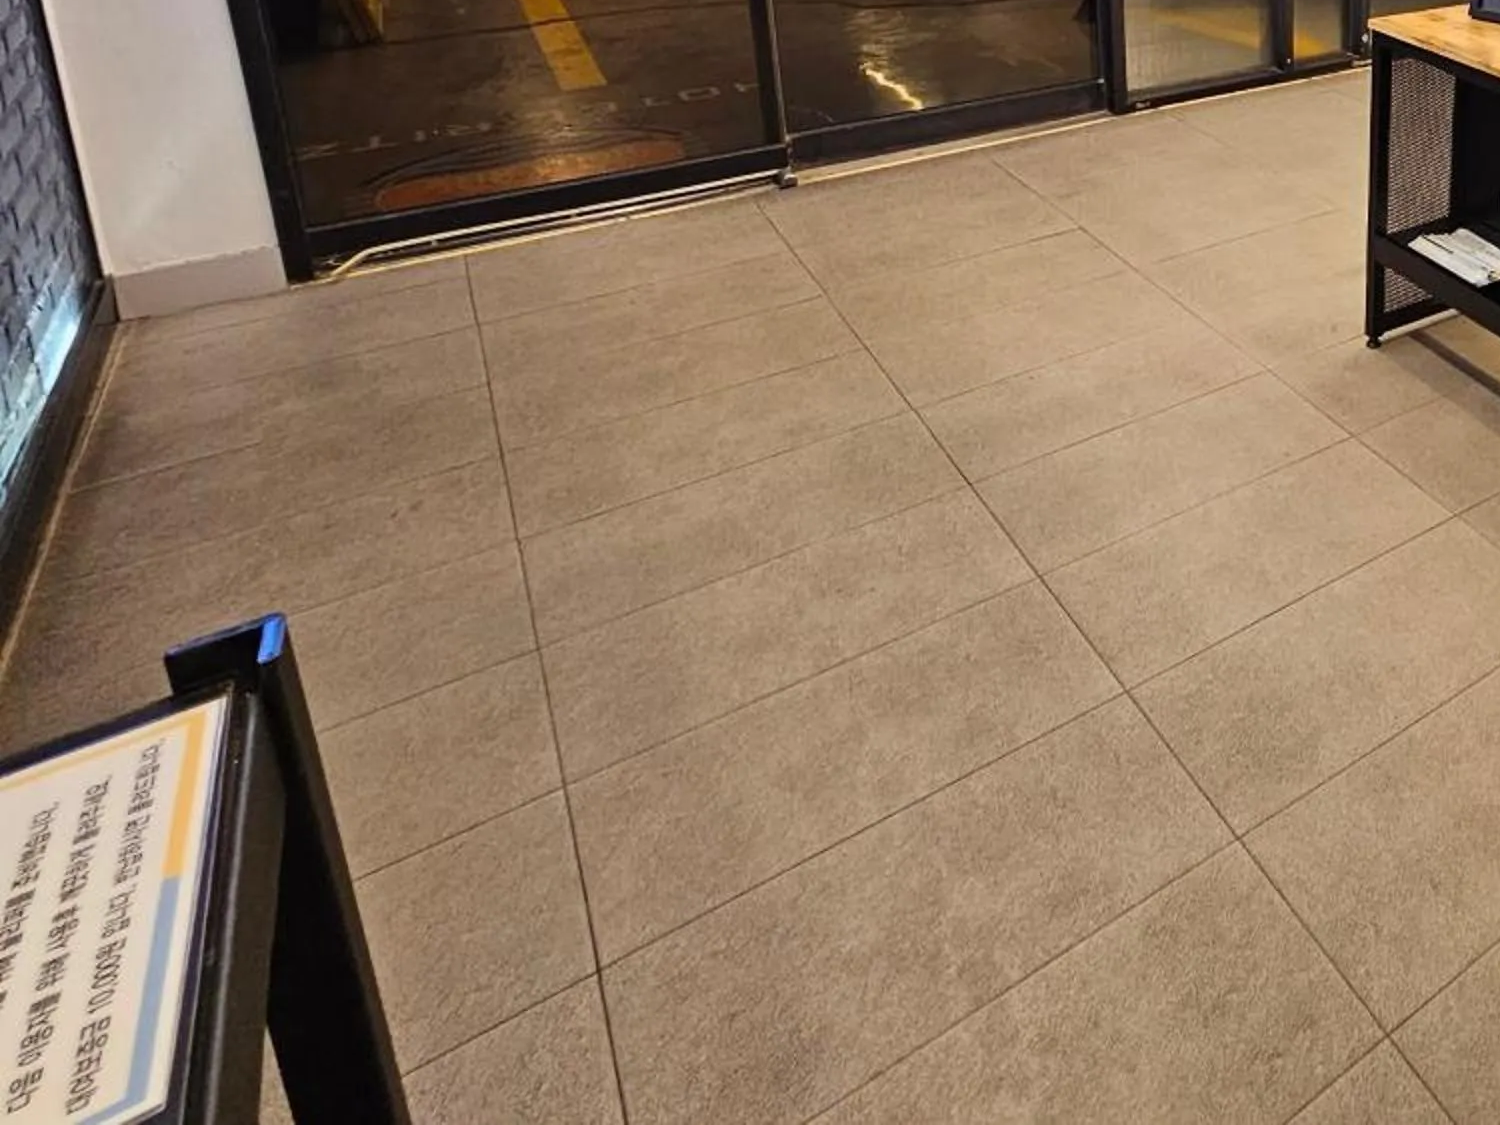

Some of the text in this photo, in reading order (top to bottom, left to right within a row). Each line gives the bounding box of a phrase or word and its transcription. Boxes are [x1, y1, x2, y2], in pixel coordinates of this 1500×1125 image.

[87, 941, 127, 1015] 10,000원
[17, 991, 60, 1067] 이용자를
[65, 1015, 111, 1116] 대여보증금
[7, 1067, 44, 1115] 다음
